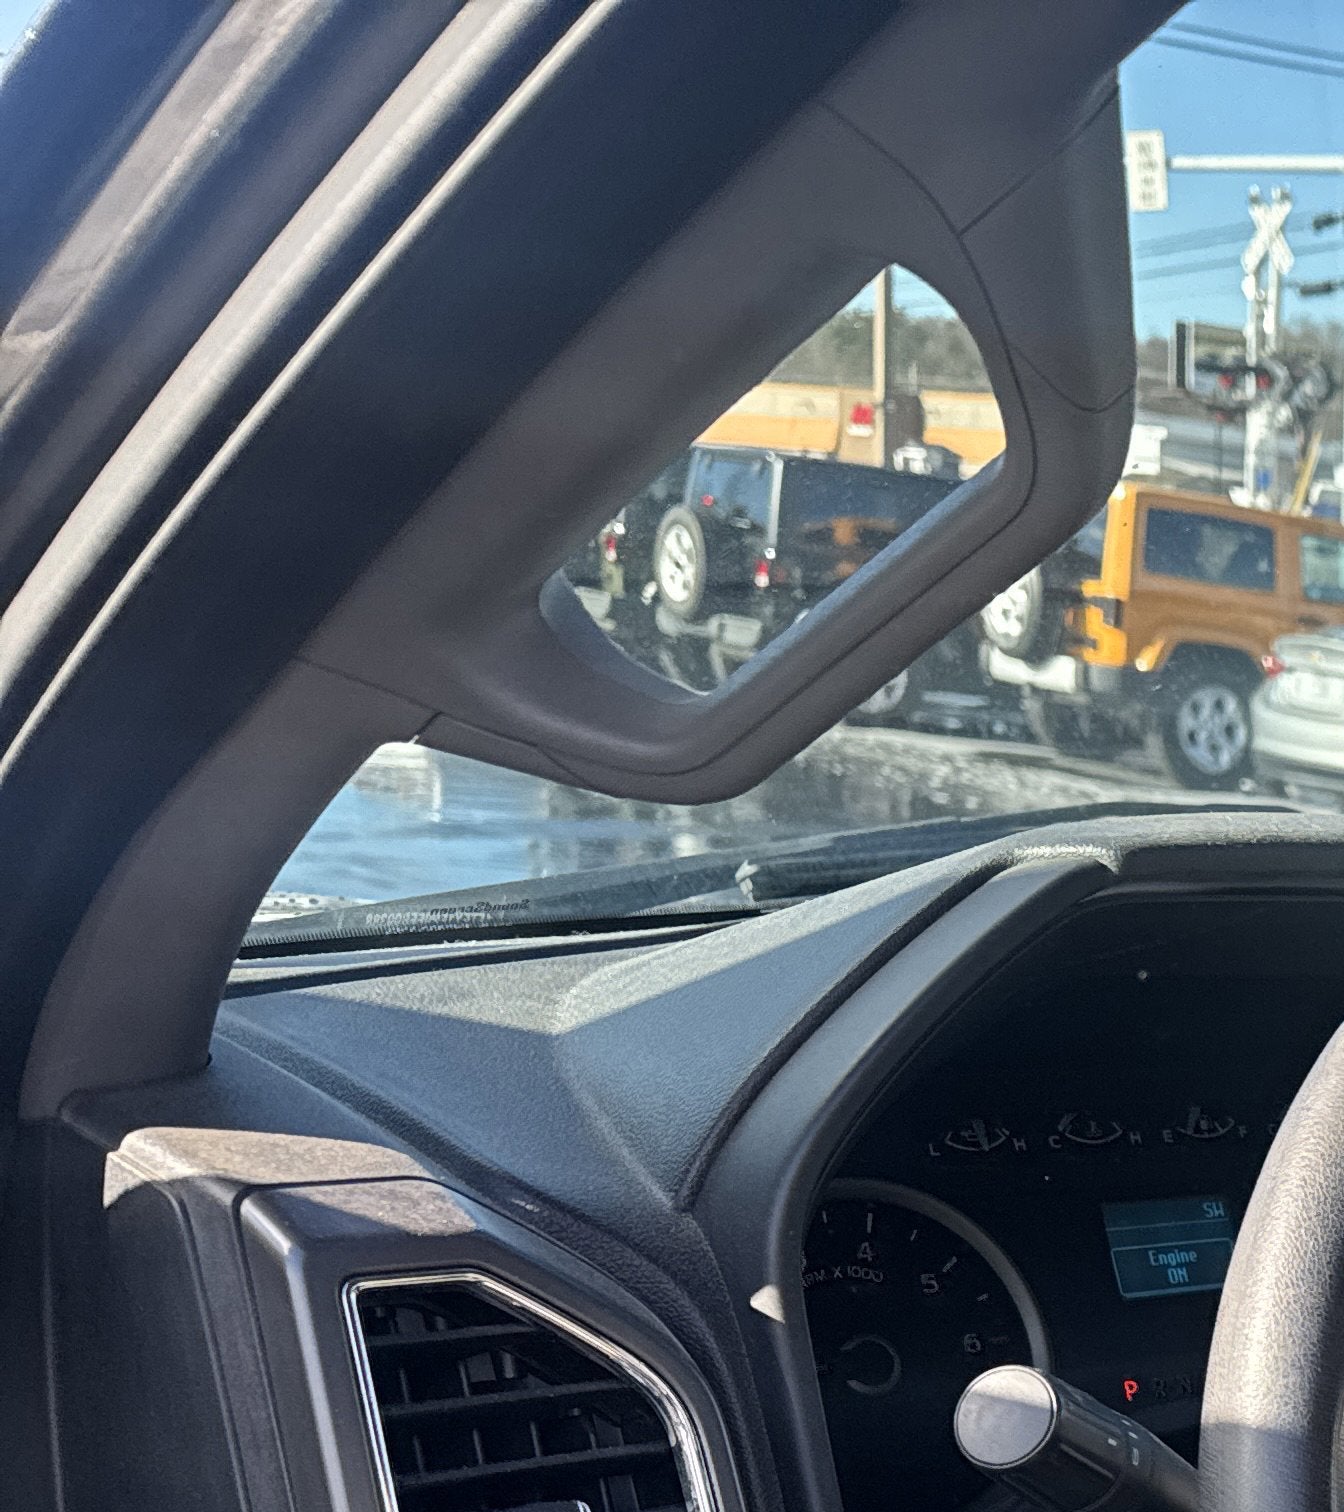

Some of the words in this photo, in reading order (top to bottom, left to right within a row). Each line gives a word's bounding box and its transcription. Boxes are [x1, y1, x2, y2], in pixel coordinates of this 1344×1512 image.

[857, 1242, 876, 1261] 4
[1148, 1249, 1198, 1267] Engine
[846, 1265, 884, 1283] 1000
[920, 1273, 940, 1294] 5
[1167, 1266, 1190, 1285] ON
[963, 1333, 981, 1353] 6
[1123, 1380, 1138, 1402] P
